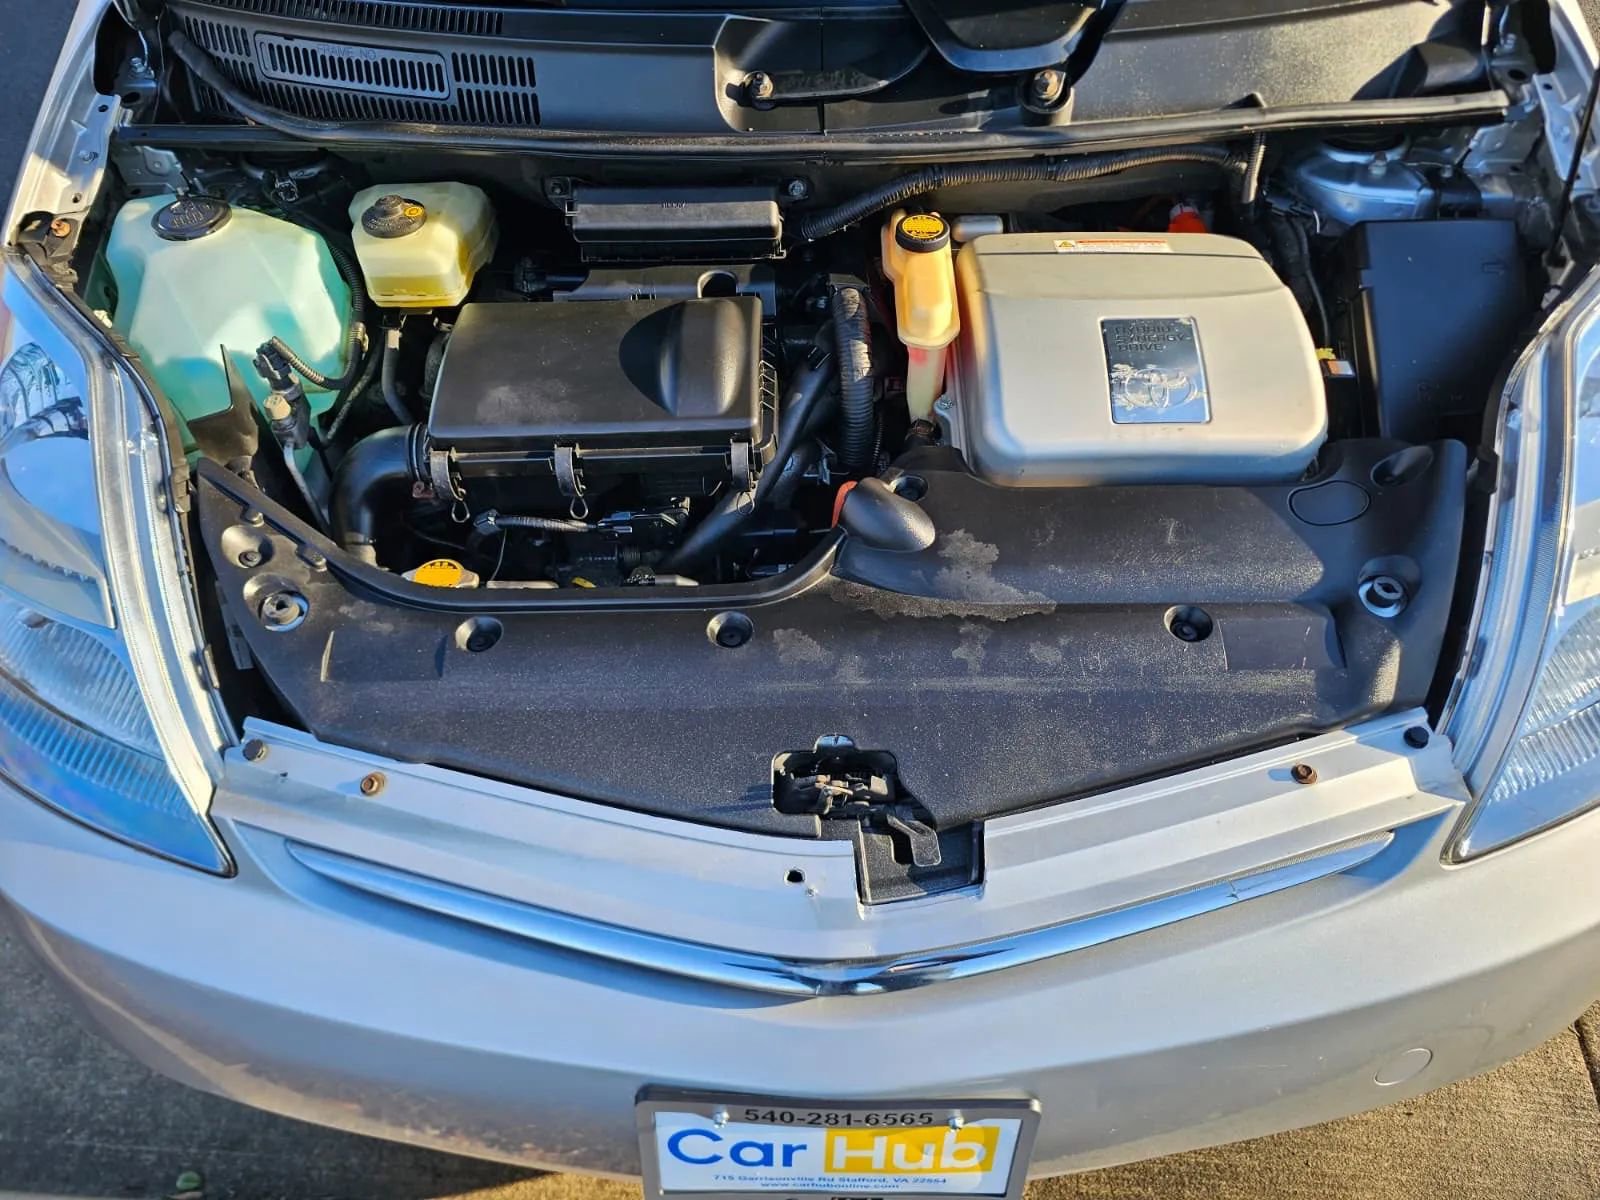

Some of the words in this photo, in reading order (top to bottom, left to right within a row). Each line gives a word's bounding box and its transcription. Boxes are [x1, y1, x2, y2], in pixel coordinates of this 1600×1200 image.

[1115, 324, 1171, 335] HYBRID
[1116, 342, 1163, 352] DRIVE
[744, 1108, 934, 1127] 540-281-6565
[667, 1128, 808, 1167] Car
[832, 1129, 986, 1169] Hub
